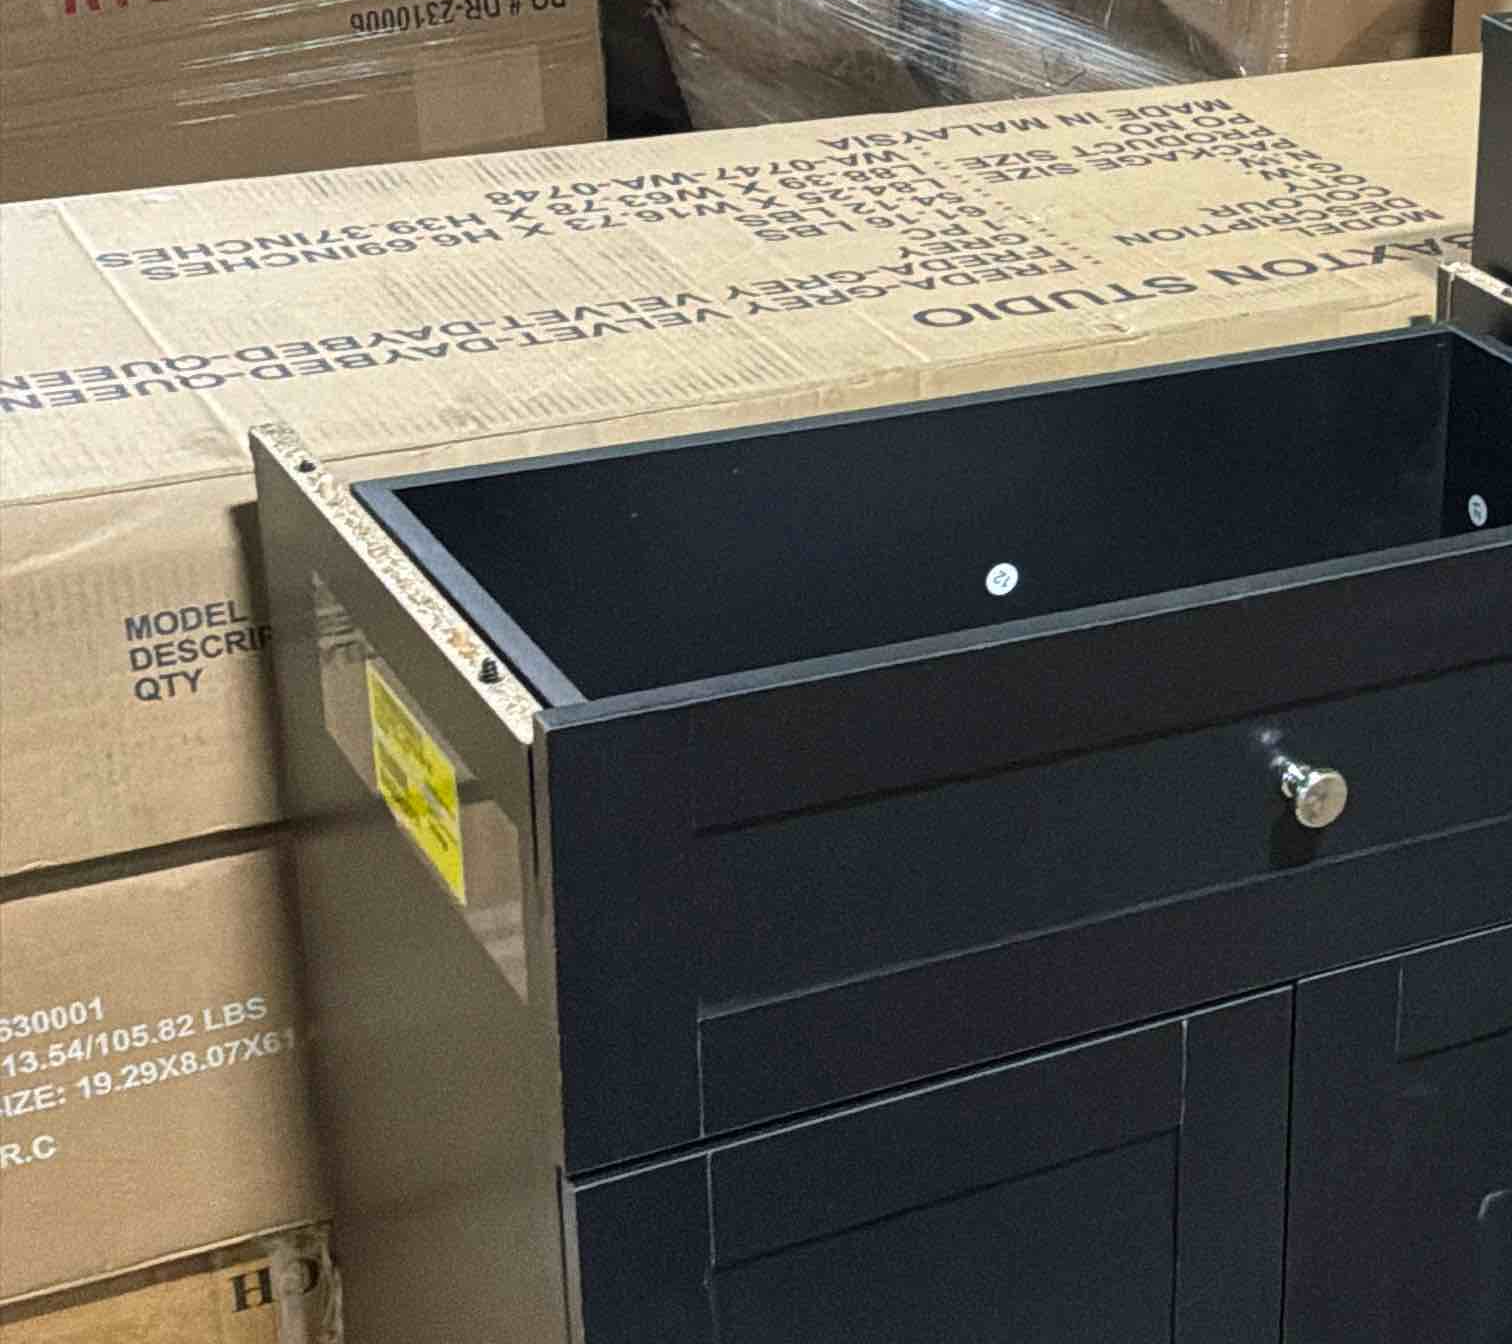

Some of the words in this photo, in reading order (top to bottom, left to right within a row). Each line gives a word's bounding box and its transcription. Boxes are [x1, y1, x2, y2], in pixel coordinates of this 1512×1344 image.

[1056, 111, 1105, 128] IN
[1108, 97, 1233, 123] MADE
[1191, 111, 1255, 128] PO
[816, 116, 1051, 150] MALAYSIA
[1072, 125, 1275, 158] PRODUCT
[956, 149, 1059, 171] SIZE
[1091, 137, 1299, 171] PACKAGE
[484, 149, 910, 206] WA-0747-WA-0748
[778, 163, 927, 190] L88.39
[975, 161, 1080, 184] SIZE
[1284, 174, 1367, 193] QTY
[731, 179, 769, 195] X
[795, 177, 946, 205] L84.25
[496, 205, 537, 223] X
[547, 187, 724, 217] W63.78
[746, 195, 779, 210] X
[842, 192, 966, 216] 54.12
[1199, 186, 1391, 218] COLOUR
[511, 221, 554, 239] X
[564, 202, 741, 232] W16.73
[734, 205, 837, 228] LBS
[864, 205, 987, 230] 61.16
[981, 219, 1008, 231] 1
[1112, 197, 1418, 247] DESCRIPTION
[1279, 209, 1445, 237] MODEL
[95, 212, 488, 269] H39.37INCHES
[752, 219, 857, 243] LBS
[899, 223, 970, 242] PC
[140, 226, 504, 281] H6.69INCHES
[898, 232, 1029, 260] GREY
[726, 244, 1055, 300] FREDA-GREY
[746, 258, 1079, 315] FREDA-GREY
[913, 275, 1198, 328] STUDIO
[0, 292, 713, 392] VELVET-DAYBED-QUEEN
[0, 307, 734, 414] VELVET-DAYBED-QUEEN
[124, 599, 249, 642] MODEL
[134, 667, 204, 702] QTY
[2, 1013, 195, 1078] 13.54/105.82
[203, 996, 268, 1032] LBS
[0, 1083, 66, 1118] IZE:
